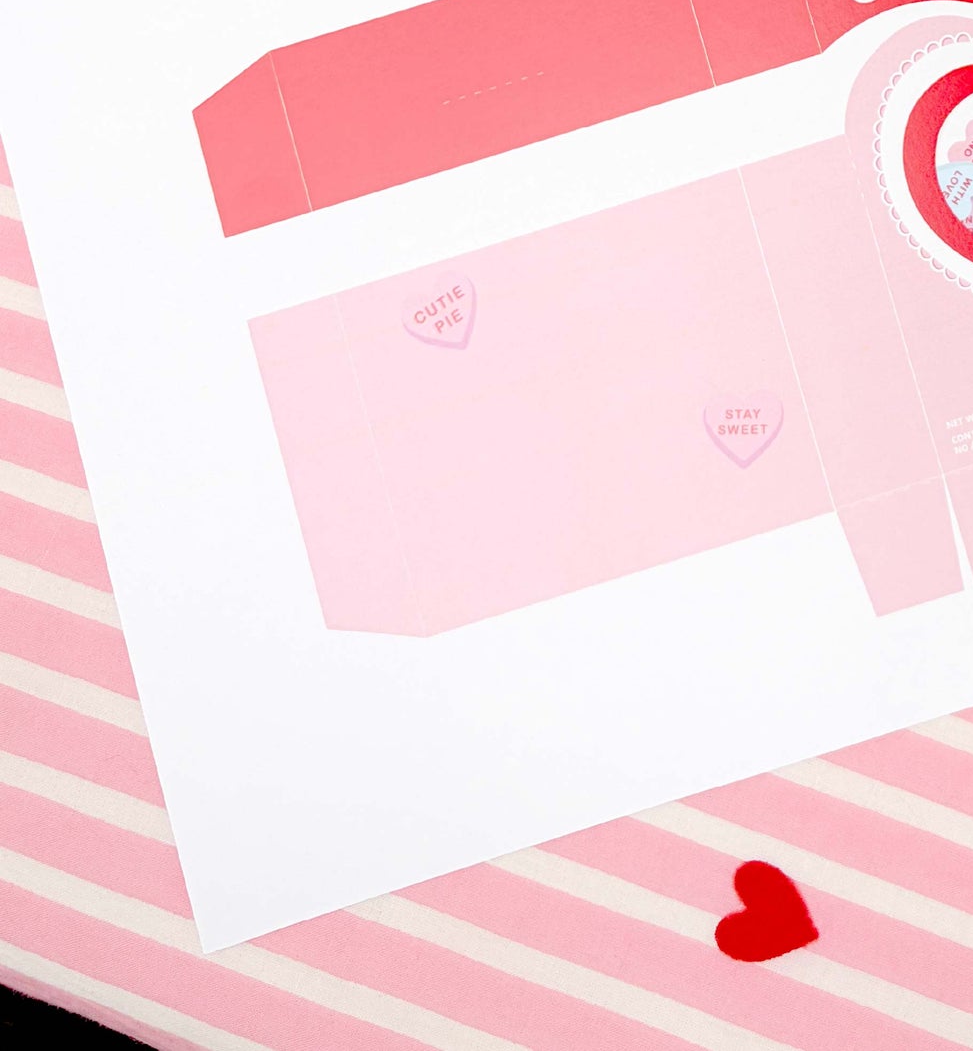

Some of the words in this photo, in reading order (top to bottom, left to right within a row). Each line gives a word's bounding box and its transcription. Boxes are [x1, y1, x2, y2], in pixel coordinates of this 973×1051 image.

[942, 170, 963, 199] LOVE
[951, 177, 973, 205] WITH
[414, 285, 465, 324] CUTIE
[434, 309, 464, 333] PIE
[725, 408, 761, 420] STAY
[718, 423, 769, 435] SWEET
[953, 444, 968, 455] NO
